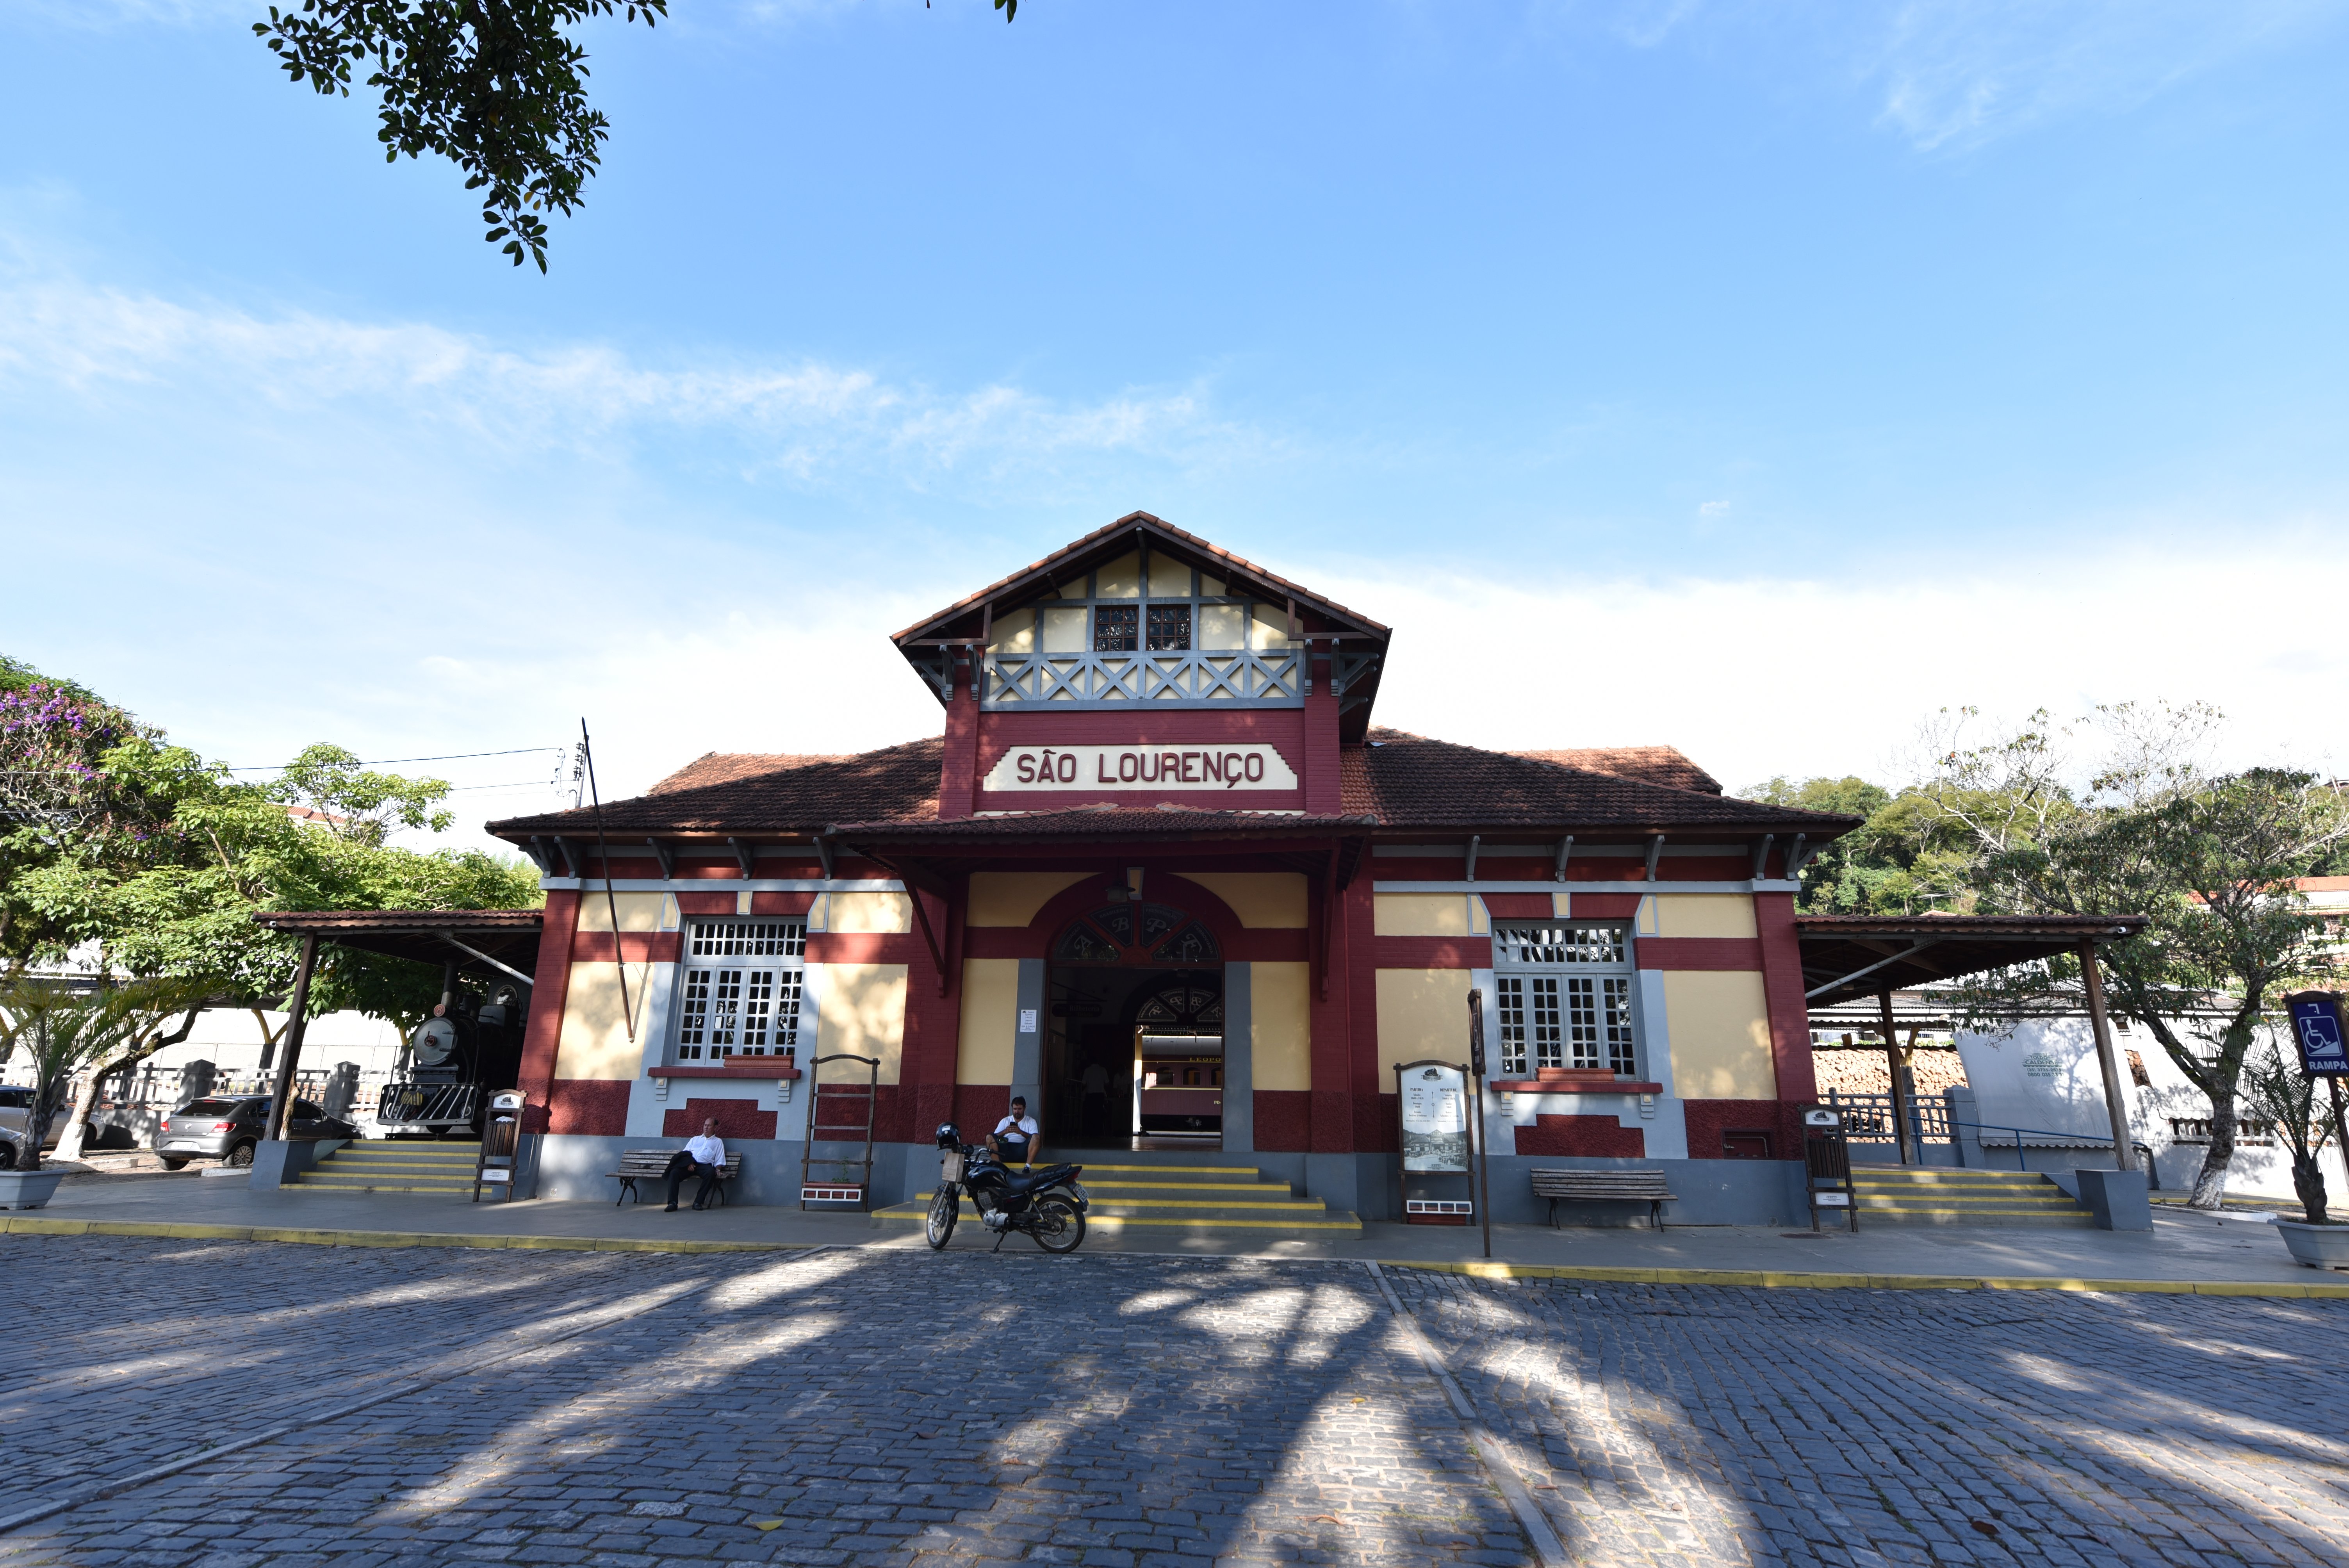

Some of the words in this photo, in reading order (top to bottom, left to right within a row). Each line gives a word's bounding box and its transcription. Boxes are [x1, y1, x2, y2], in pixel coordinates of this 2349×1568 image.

[1017, 748, 1076, 783] SÃO
[1098, 752, 1264, 788] LOURENÇO
[1099, 907, 1128, 918] BRASILEIRA
[1112, 917, 1129, 933] B
[1145, 918, 1167, 932] P
[437, 1006, 442, 1015] 8
[2308, 1061, 2349, 1070] RAMPA
